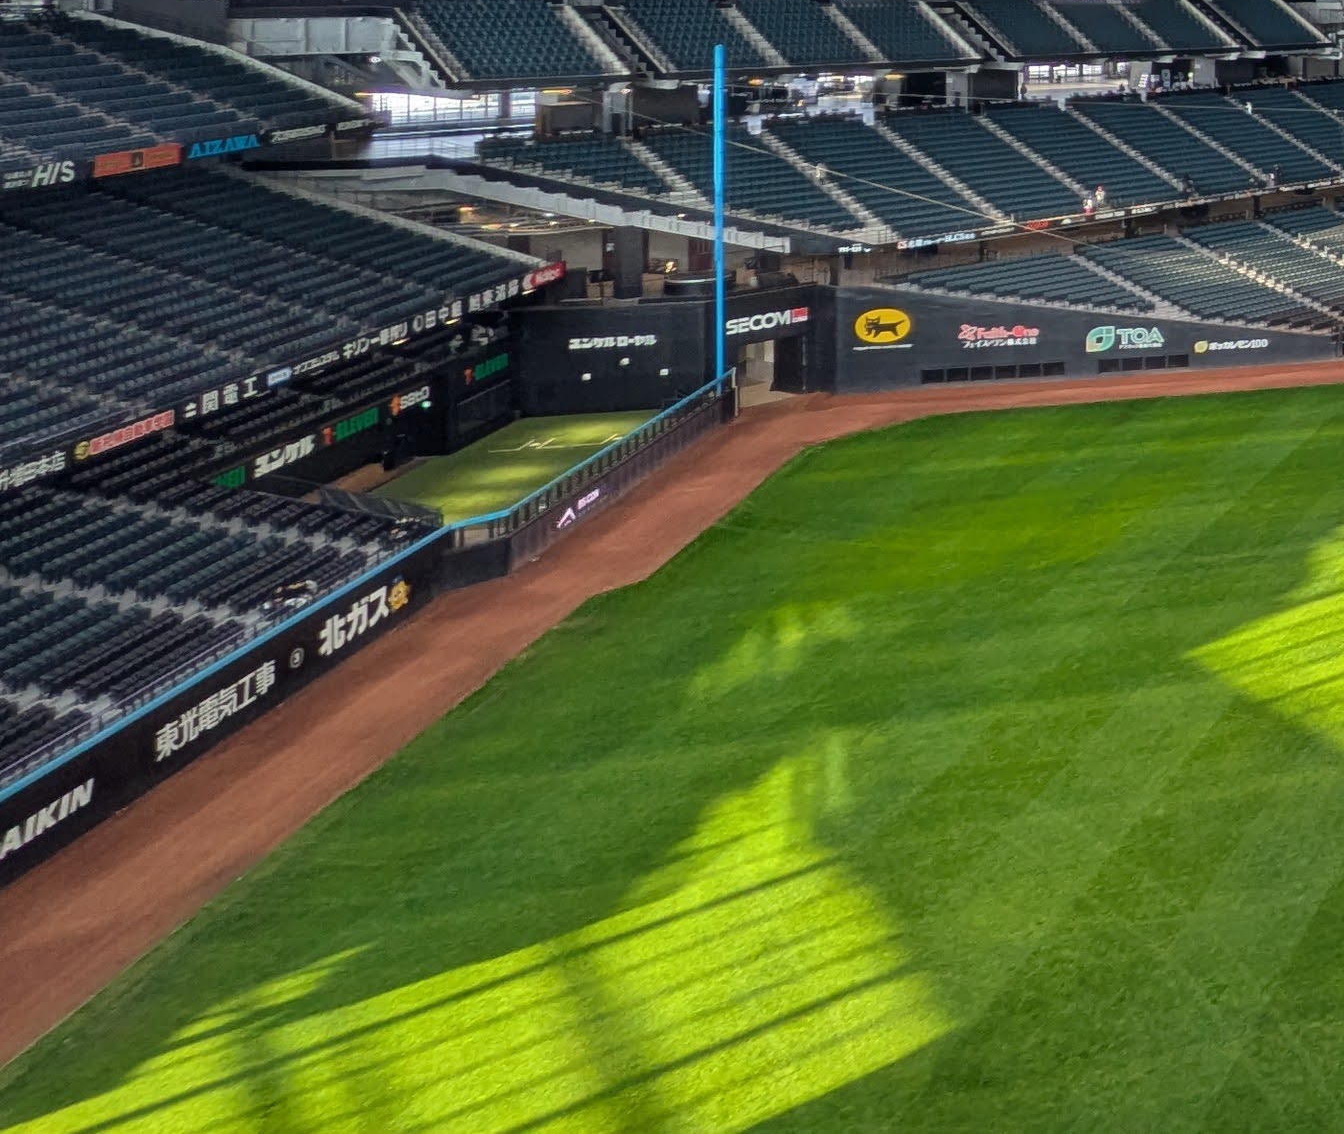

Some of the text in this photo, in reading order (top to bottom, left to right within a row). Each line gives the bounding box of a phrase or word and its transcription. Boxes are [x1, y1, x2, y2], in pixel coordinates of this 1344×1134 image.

[725, 309, 792, 336] SECOM
[1115, 326, 1165, 345] TOA
[317, 584, 391, 657] 北ガス
[155, 659, 277, 763] 東光電気工事
[0, 778, 95, 859] AIKIN
